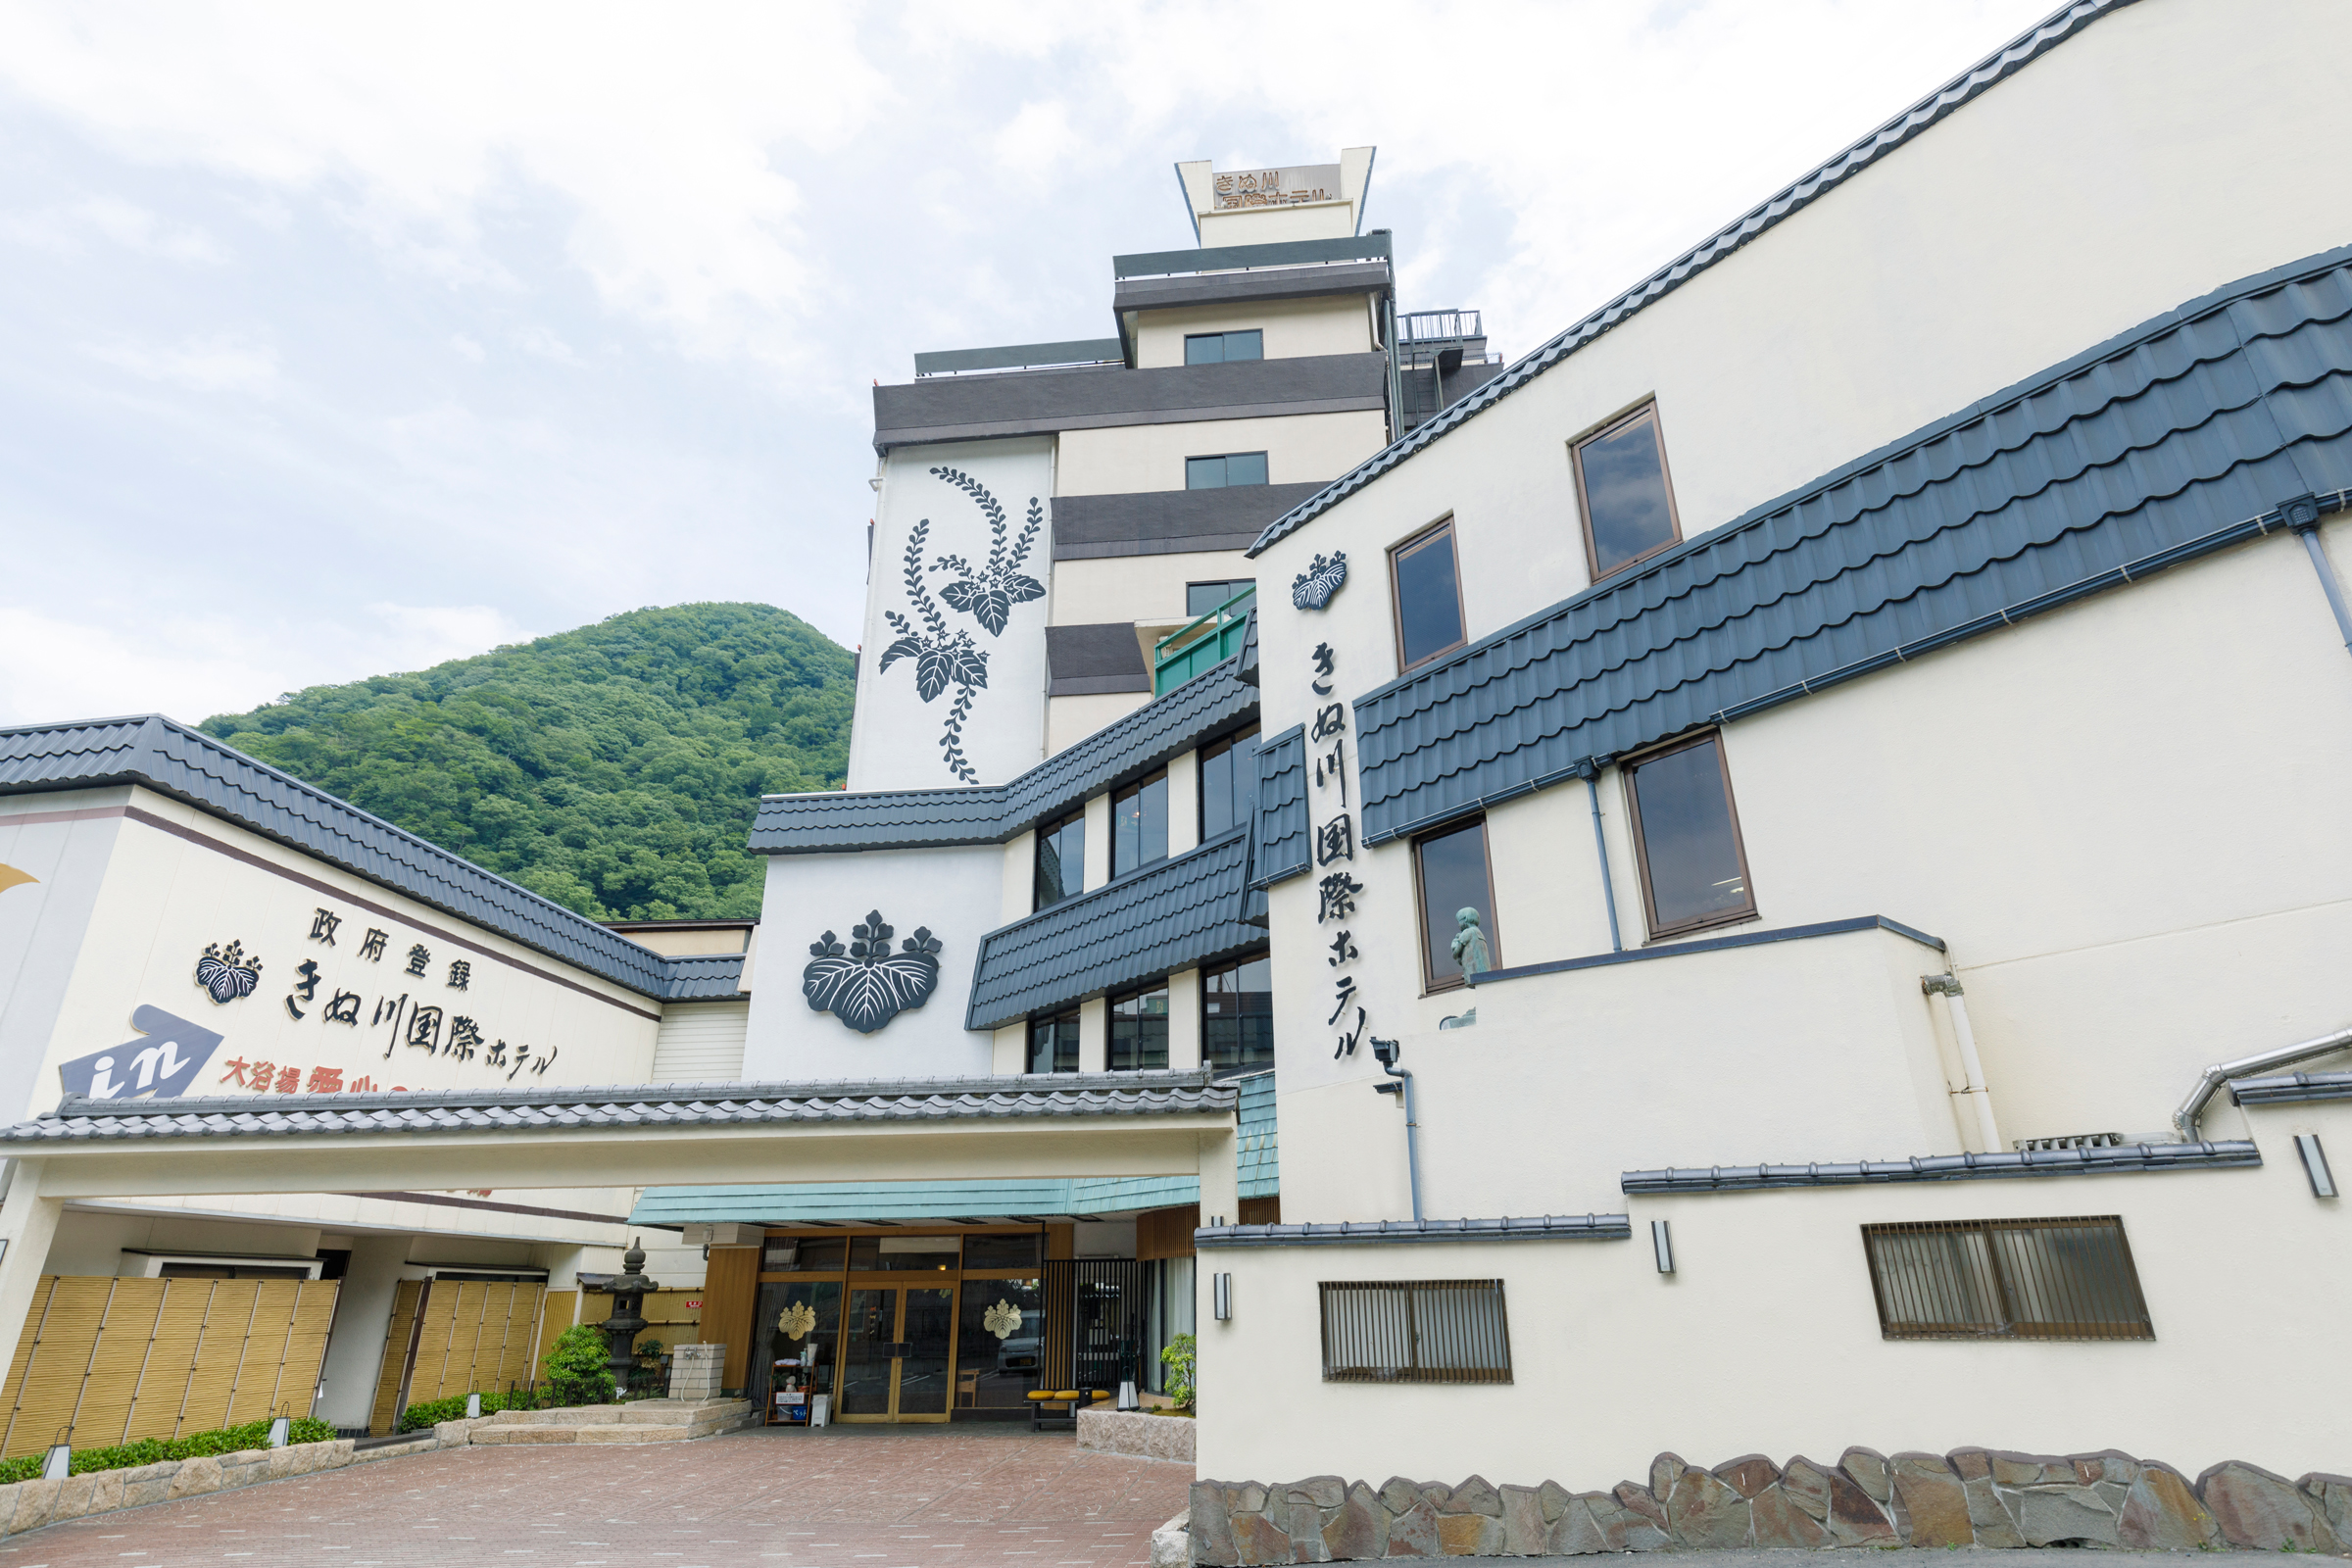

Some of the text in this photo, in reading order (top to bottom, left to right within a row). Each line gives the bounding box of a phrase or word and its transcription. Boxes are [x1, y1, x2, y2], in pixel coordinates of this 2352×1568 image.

[1216, 171, 1280, 195] きぬ川
[1310, 641, 1366, 1060] きぬ川国際ホテル
[309, 906, 471, 992] 政府登録
[284, 957, 558, 1081] きぬ川国際ホテル
[88, 1041, 191, 1099] in
